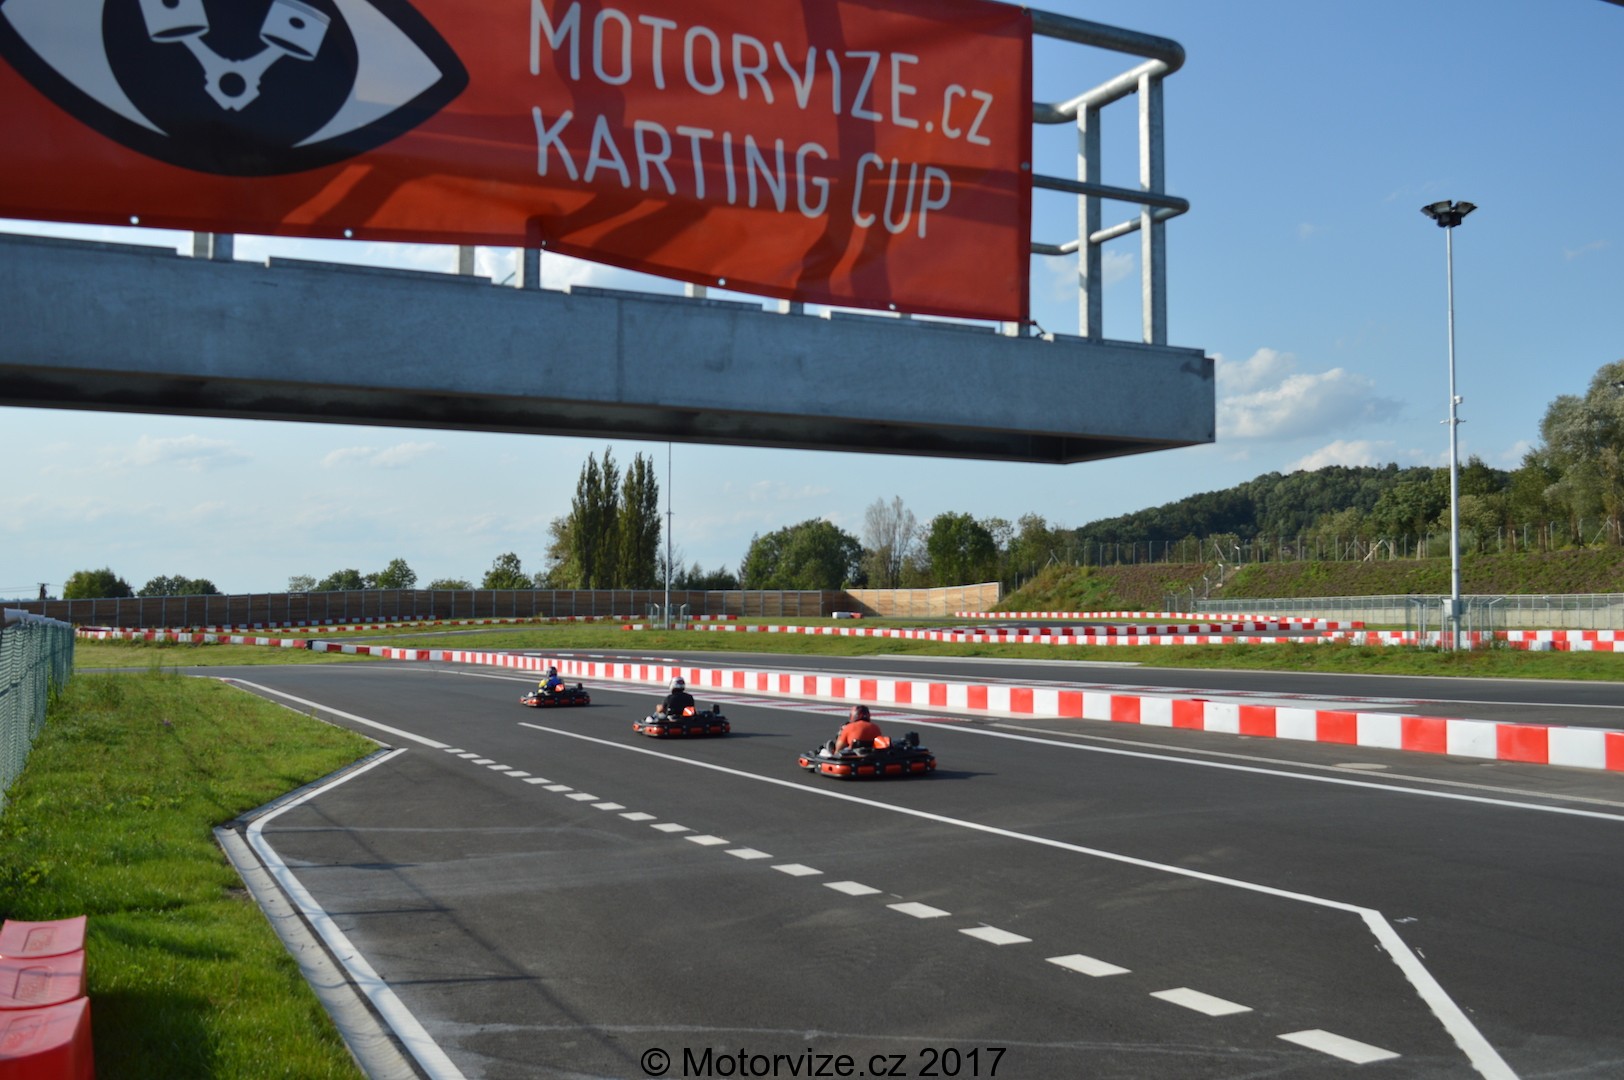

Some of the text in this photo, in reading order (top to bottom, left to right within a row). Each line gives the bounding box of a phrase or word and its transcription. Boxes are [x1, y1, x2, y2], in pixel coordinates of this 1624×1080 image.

[529, 0, 994, 146] MOTORVIZE.CZ
[532, 106, 952, 239] KARTING CUP
